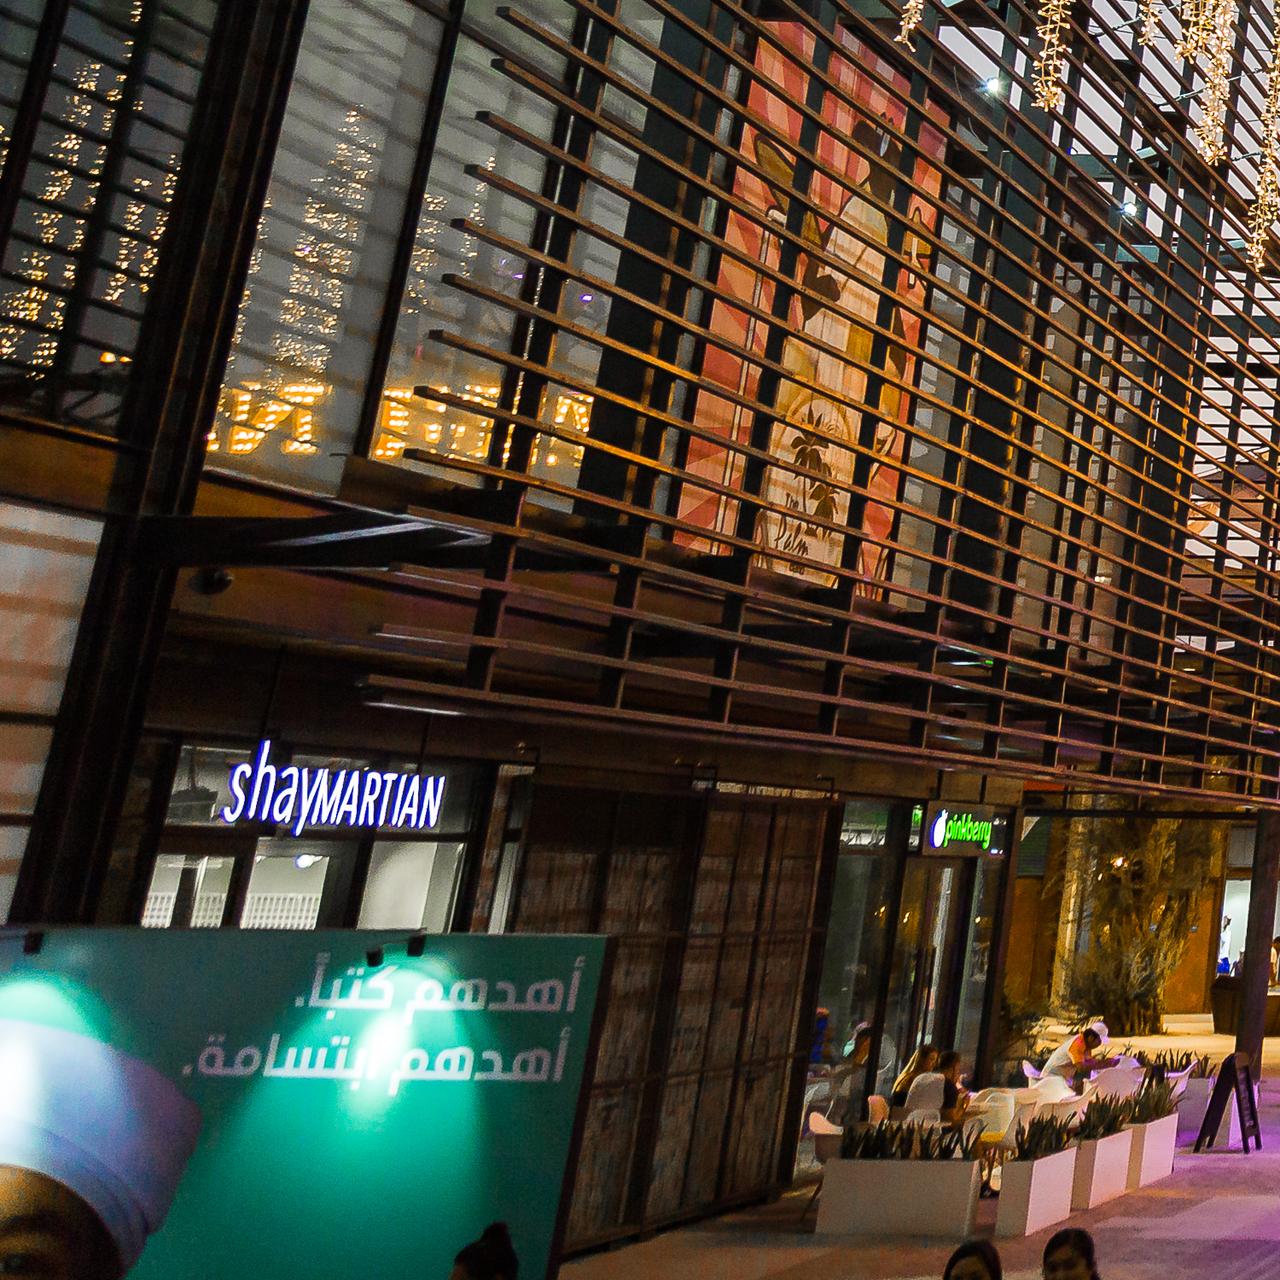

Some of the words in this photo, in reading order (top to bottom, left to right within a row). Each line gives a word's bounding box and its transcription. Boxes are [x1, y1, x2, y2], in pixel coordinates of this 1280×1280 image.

[221, 739, 447, 838] shayMARTIAN
[943, 813, 992, 850] pinkberry
[406, 955, 586, 1023] أهدهم
[388, 1027, 571, 1096] أهدهم
